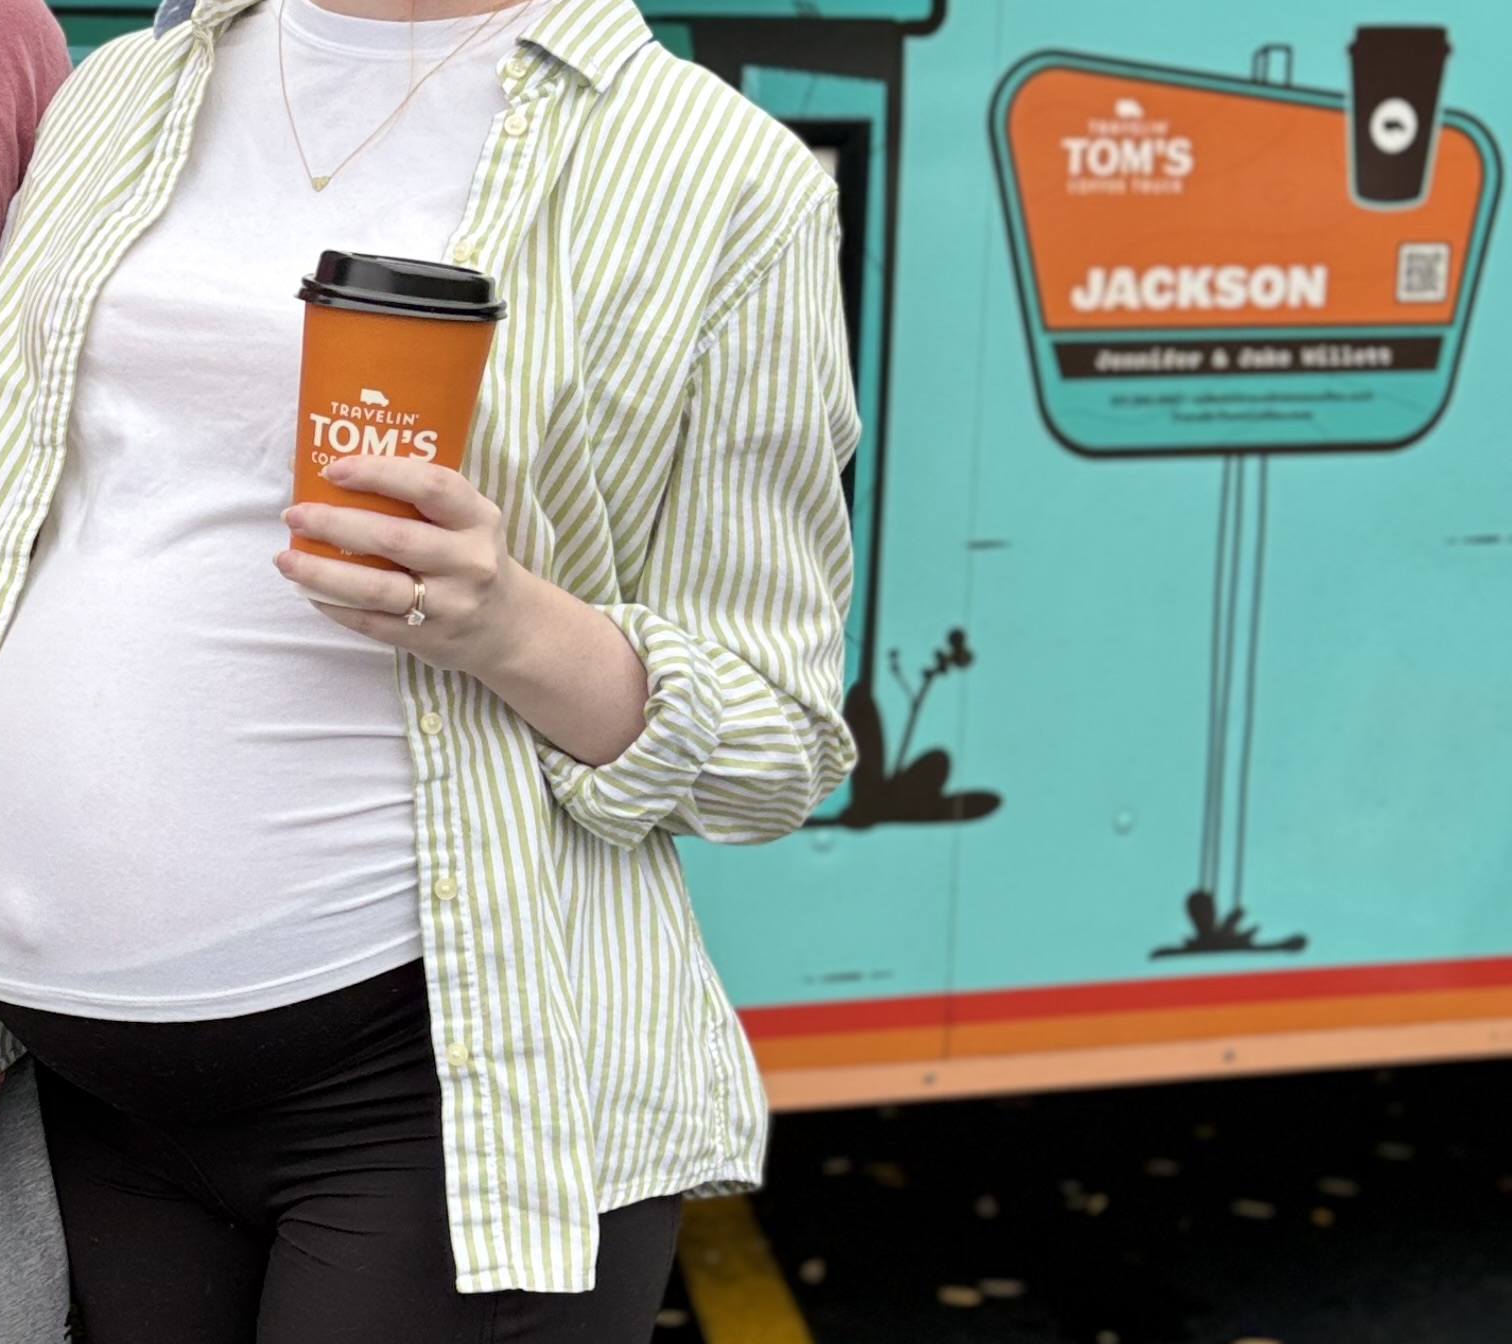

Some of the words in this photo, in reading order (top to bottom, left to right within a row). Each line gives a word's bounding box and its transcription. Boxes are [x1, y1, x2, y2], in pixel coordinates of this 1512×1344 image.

[1060, 135, 1195, 177] TOM'S
[1070, 265, 1327, 311] JACKSON
[330, 401, 419, 425] TRAVELIN'
[309, 412, 438, 463] TOM'S
